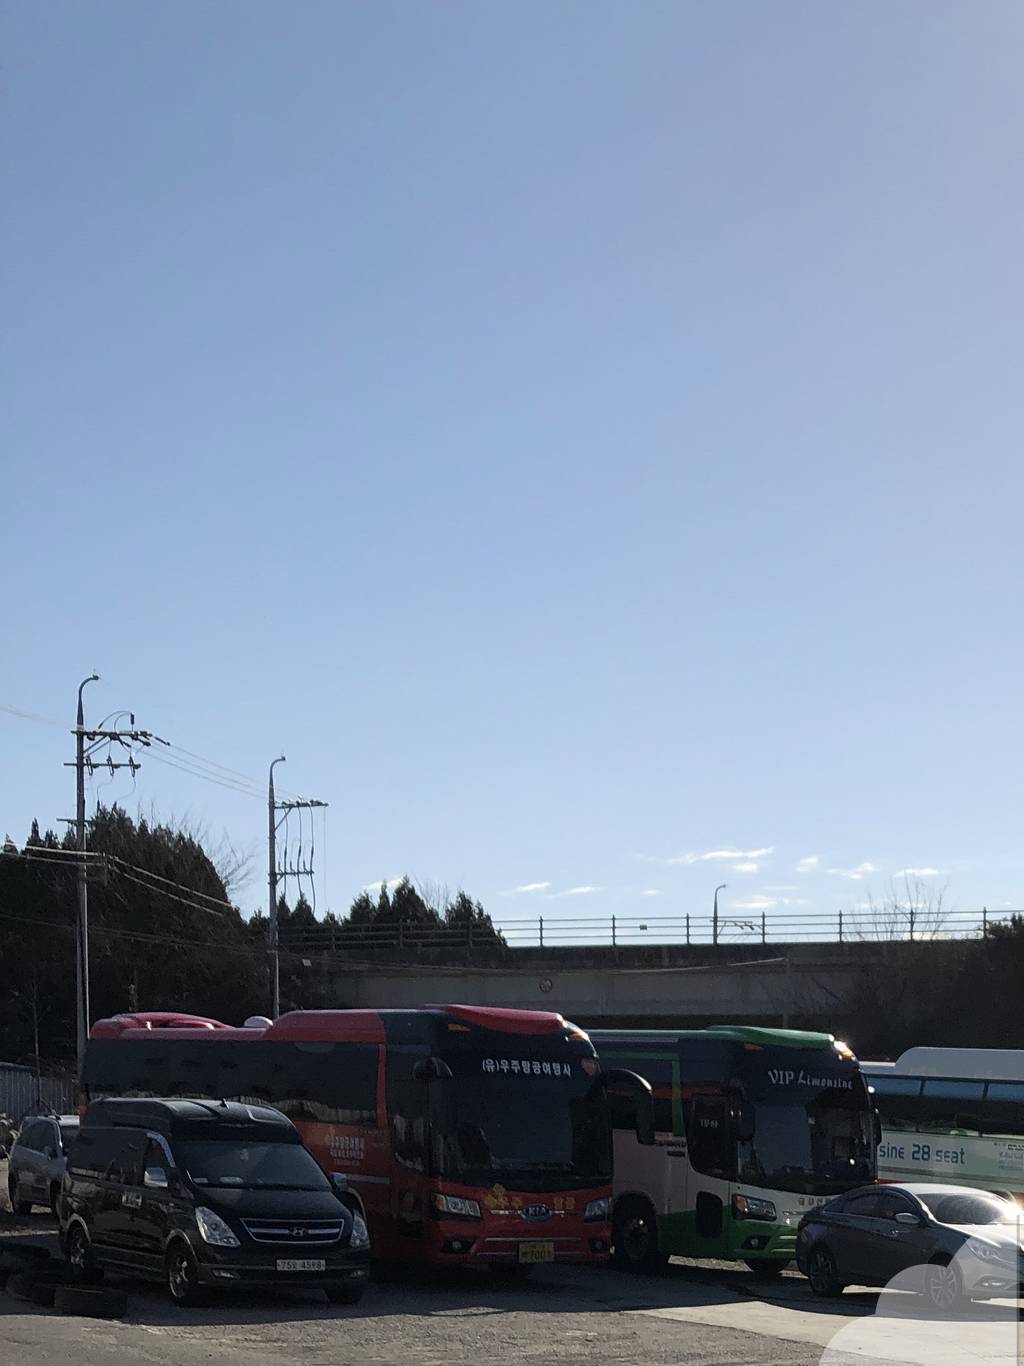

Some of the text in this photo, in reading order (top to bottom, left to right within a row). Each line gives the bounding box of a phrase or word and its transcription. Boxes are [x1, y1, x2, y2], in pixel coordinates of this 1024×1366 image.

[767, 1068, 795, 1086] VIP
[911, 1144, 931, 1161] 28
[936, 1147, 965, 1165] seat
